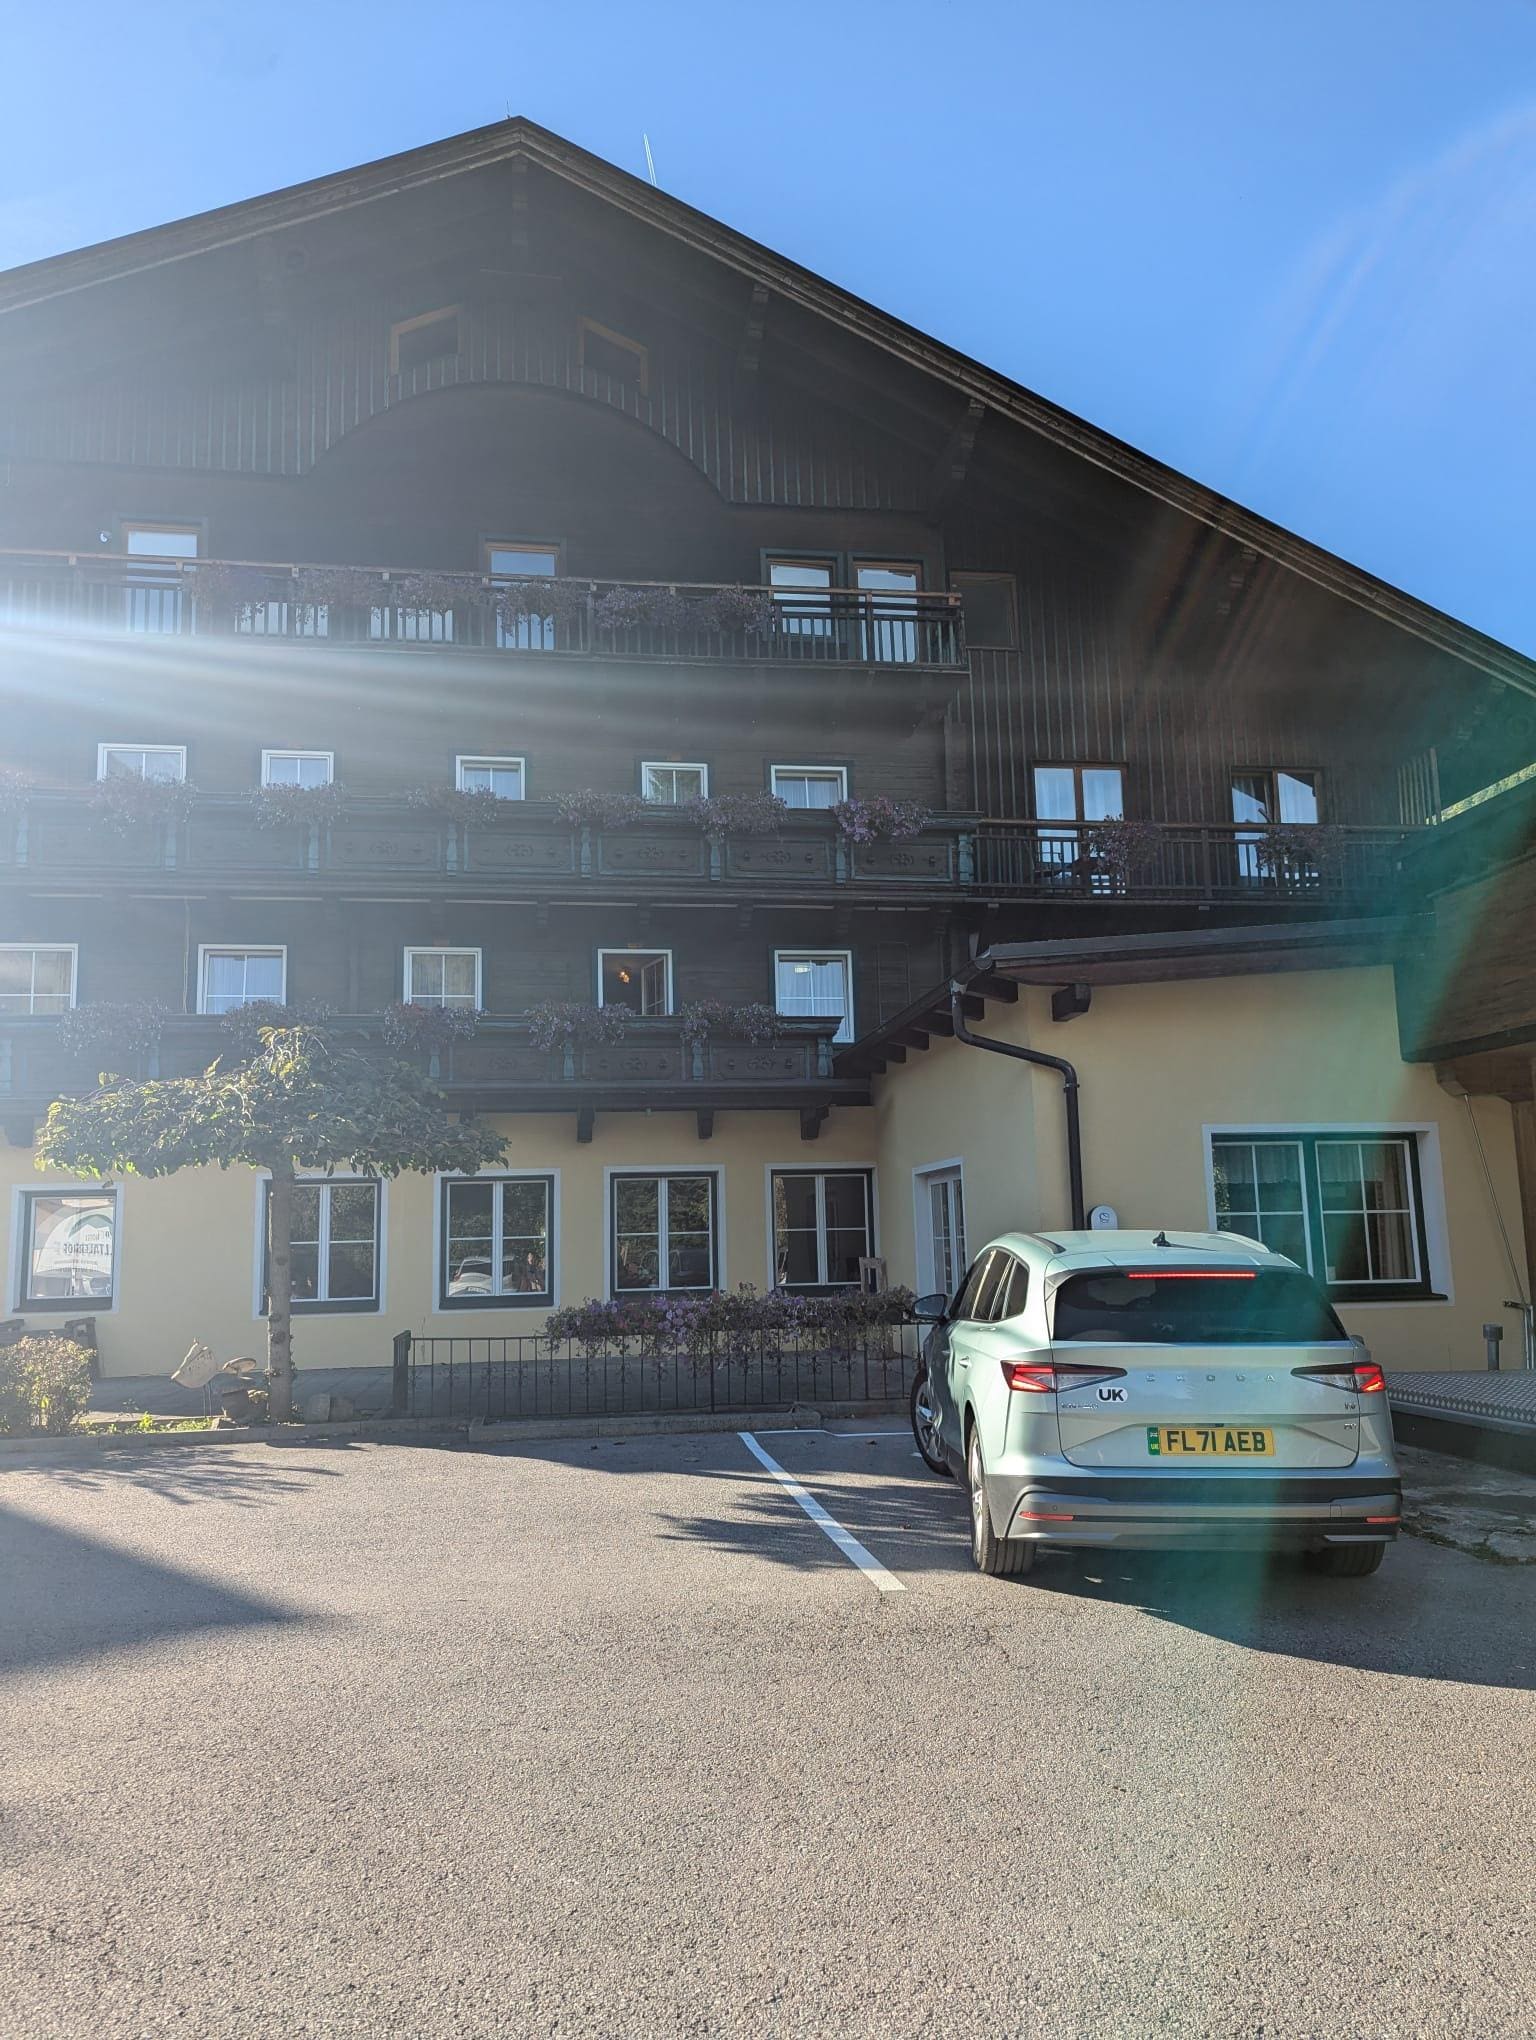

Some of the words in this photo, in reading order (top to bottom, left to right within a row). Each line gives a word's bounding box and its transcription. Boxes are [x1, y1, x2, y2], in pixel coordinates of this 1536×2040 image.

[1099, 1389, 1124, 1402] UK
[1166, 1430, 1217, 1452] FL71
[1224, 1431, 1266, 1452] AEB
